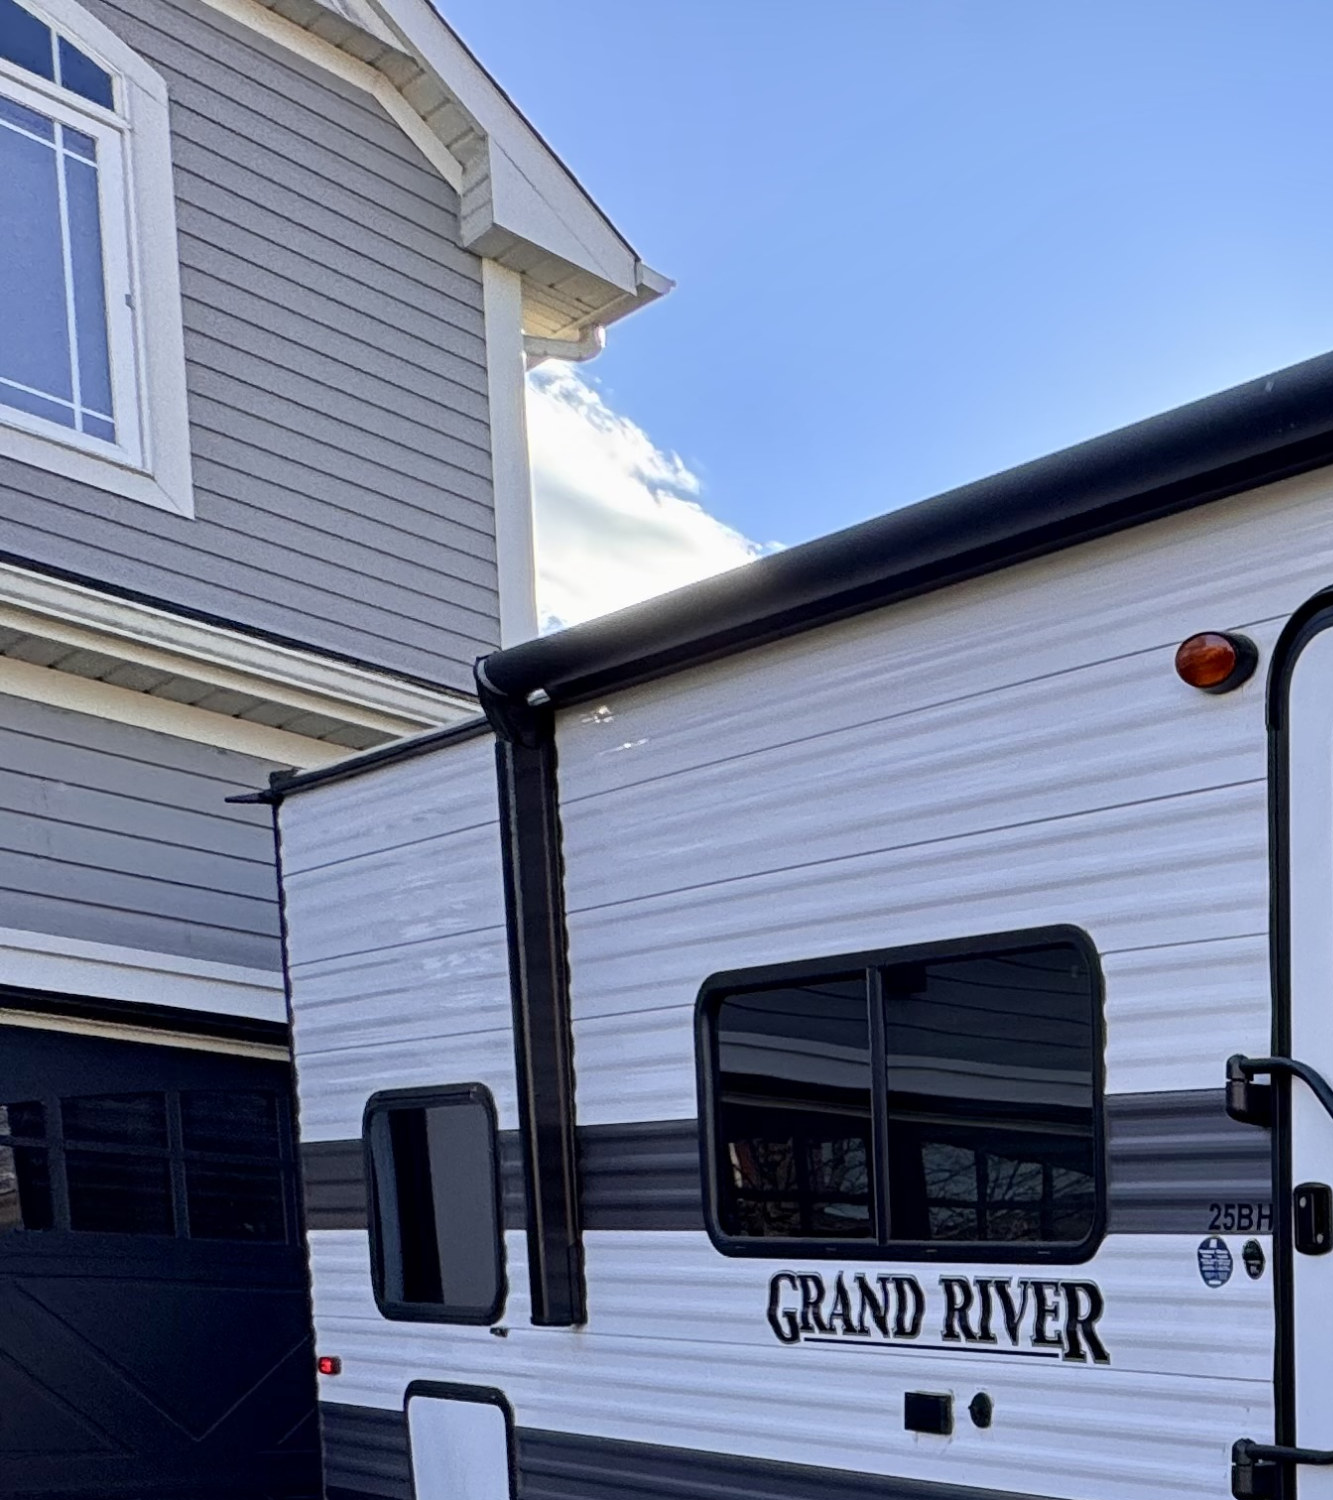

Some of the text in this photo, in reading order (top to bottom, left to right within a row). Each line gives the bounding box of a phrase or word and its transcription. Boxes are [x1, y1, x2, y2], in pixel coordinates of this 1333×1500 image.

[1208, 1203, 1274, 1231] 25BH
[766, 1269, 1111, 1365] GRAND RIVER
